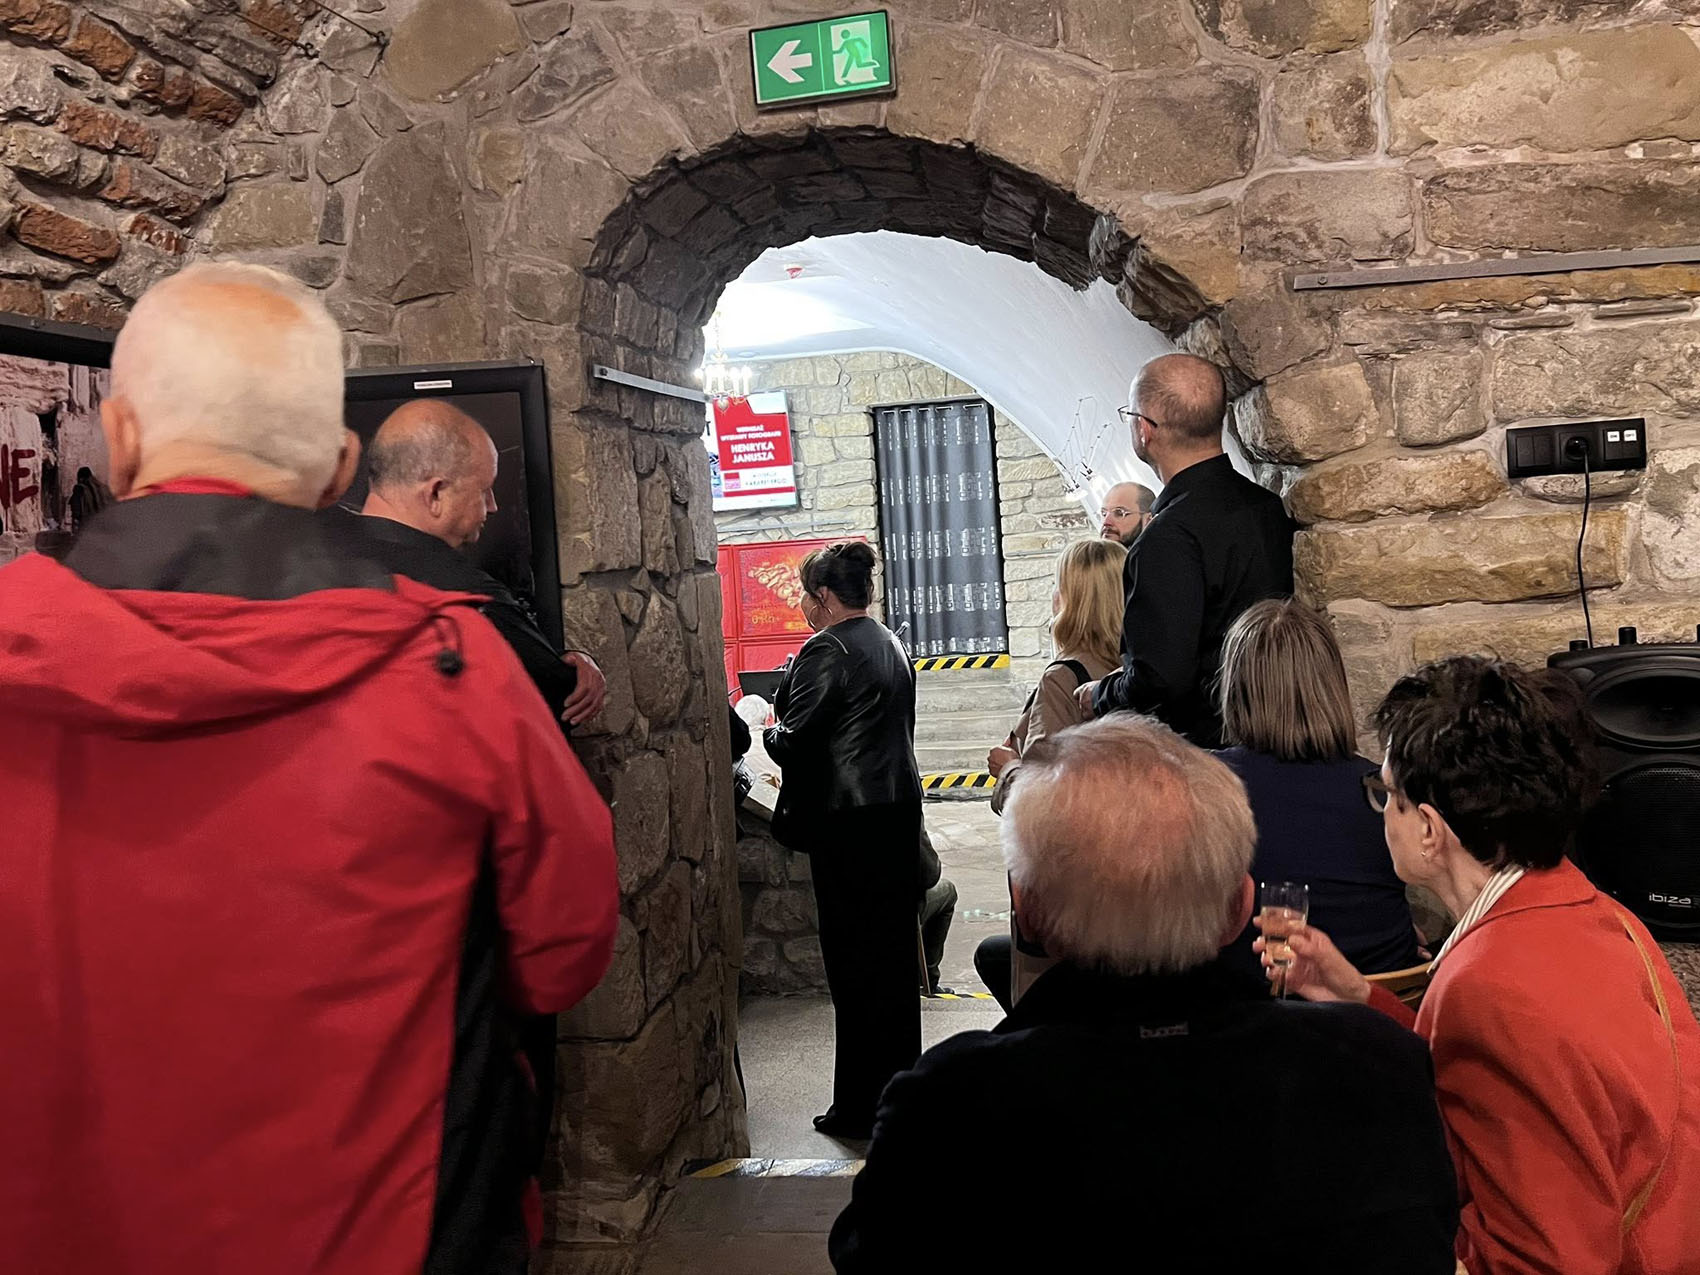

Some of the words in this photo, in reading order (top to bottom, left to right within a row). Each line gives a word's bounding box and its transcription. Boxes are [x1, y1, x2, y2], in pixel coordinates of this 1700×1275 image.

[730, 440, 775, 454] HENRYKA
[732, 451, 775, 464] JANUSZA
[1648, 891, 1692, 904] ibiza
